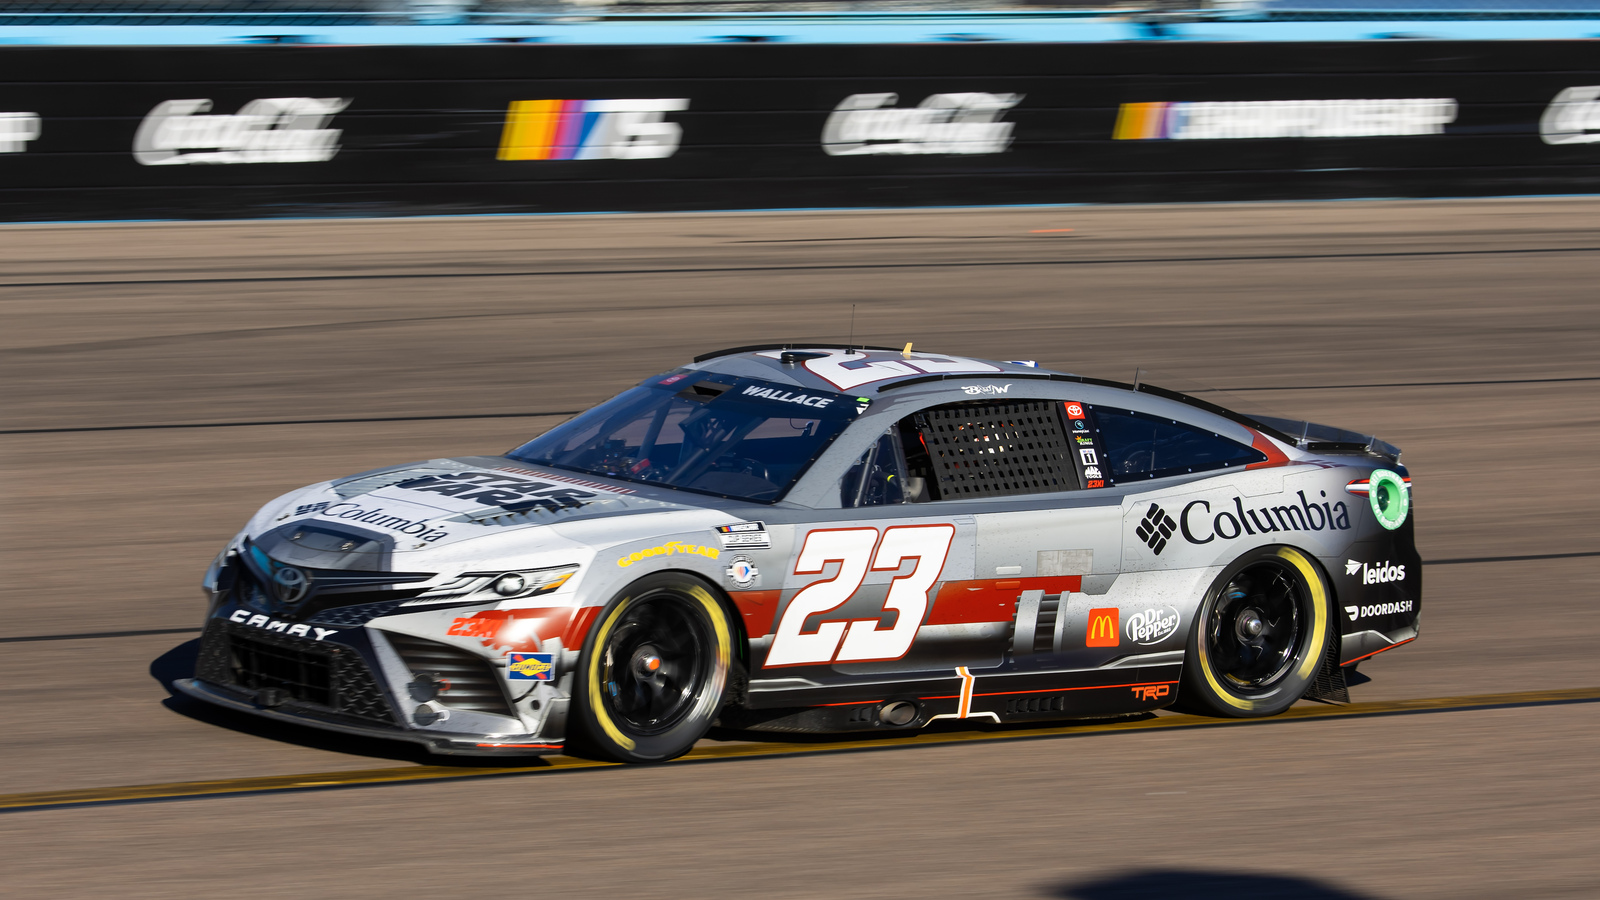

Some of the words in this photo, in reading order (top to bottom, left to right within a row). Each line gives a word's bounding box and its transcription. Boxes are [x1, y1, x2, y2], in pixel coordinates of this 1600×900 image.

[740, 384, 835, 410] WALLACE
[1087, 480, 1104, 488] 23XI
[322, 502, 450, 544] Columbia
[1180, 489, 1351, 545] Columbia
[617, 541, 720, 568] GOODYEAR
[1363, 560, 1406, 585] leidos
[761, 523, 956, 669] 23
[1144, 608, 1164, 626] Dr
[1360, 600, 1413, 618] DOORDASH
[1131, 684, 1170, 701] TRD
